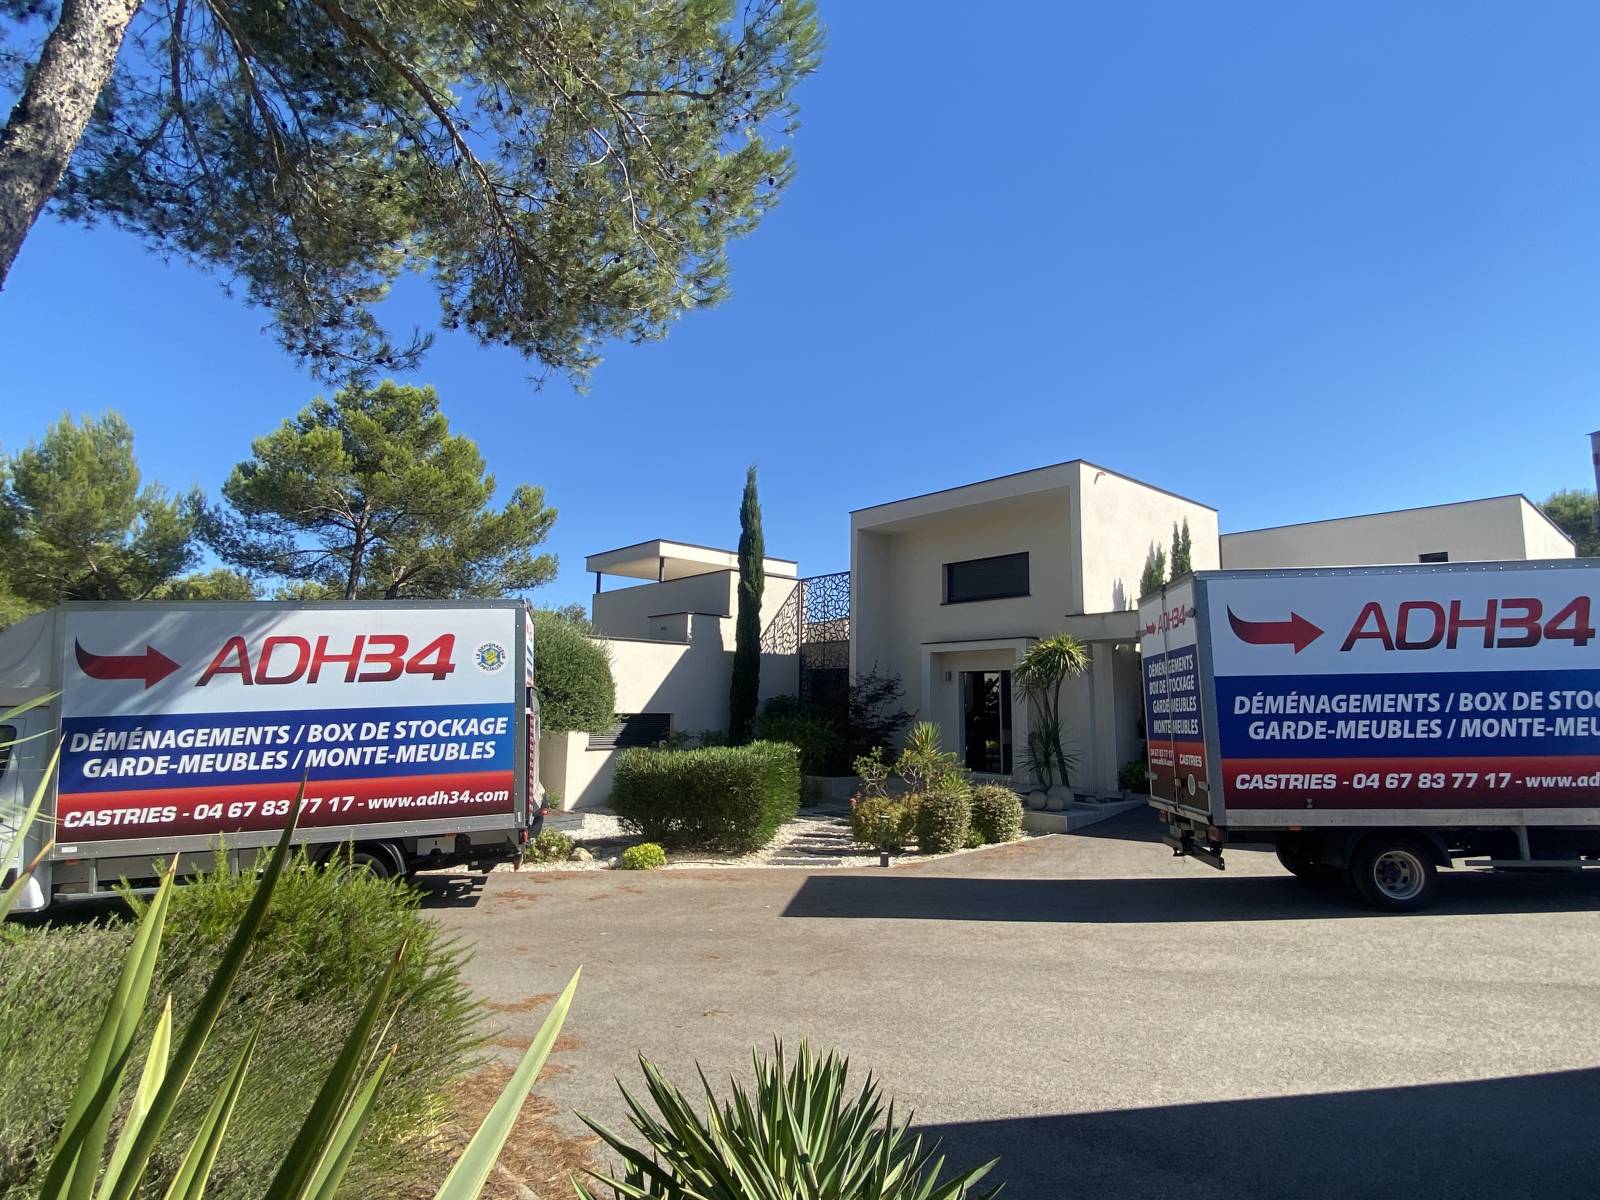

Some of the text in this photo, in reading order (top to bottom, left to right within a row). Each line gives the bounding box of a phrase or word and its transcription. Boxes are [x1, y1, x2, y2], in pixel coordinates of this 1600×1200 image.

[1157, 604, 1186, 635] ADH34
[1340, 596, 1596, 652] ADH34
[194, 633, 456, 687] ADH34
[1166, 674, 1195, 693] TOCKAGE
[1234, 691, 1441, 715] DÉMÉNAGEMENTS
[1458, 692, 1508, 712] BOX
[1512, 691, 1543, 711] DE
[70, 725, 290, 753] DÉMÉNAGEMENTS
[307, 722, 357, 743] BOX
[359, 721, 391, 741] DE
[393, 717, 509, 739] STOCKAGE
[1248, 719, 1442, 740] GARDE-MEUBLES
[82, 750, 289, 778] GARDE-MEUBLES
[305, 741, 497, 768] MONTE-MEUBLES
[1235, 773, 1337, 790] CASTRIES
[1352, 773, 1380, 789] 04
[1385, 773, 1413, 789] 67
[1417, 773, 1446, 789] 83
[1451, 772, 1479, 789] 77
[1484, 772, 1512, 789] 17
[64, 806, 178, 828] CASTRIES
[193, 803, 223, 820] 04
[227, 801, 257, 818] 67
[261, 799, 290, 816] 83
[328, 796, 355, 812] 17
[368, 790, 509, 810] www.adh34.com
